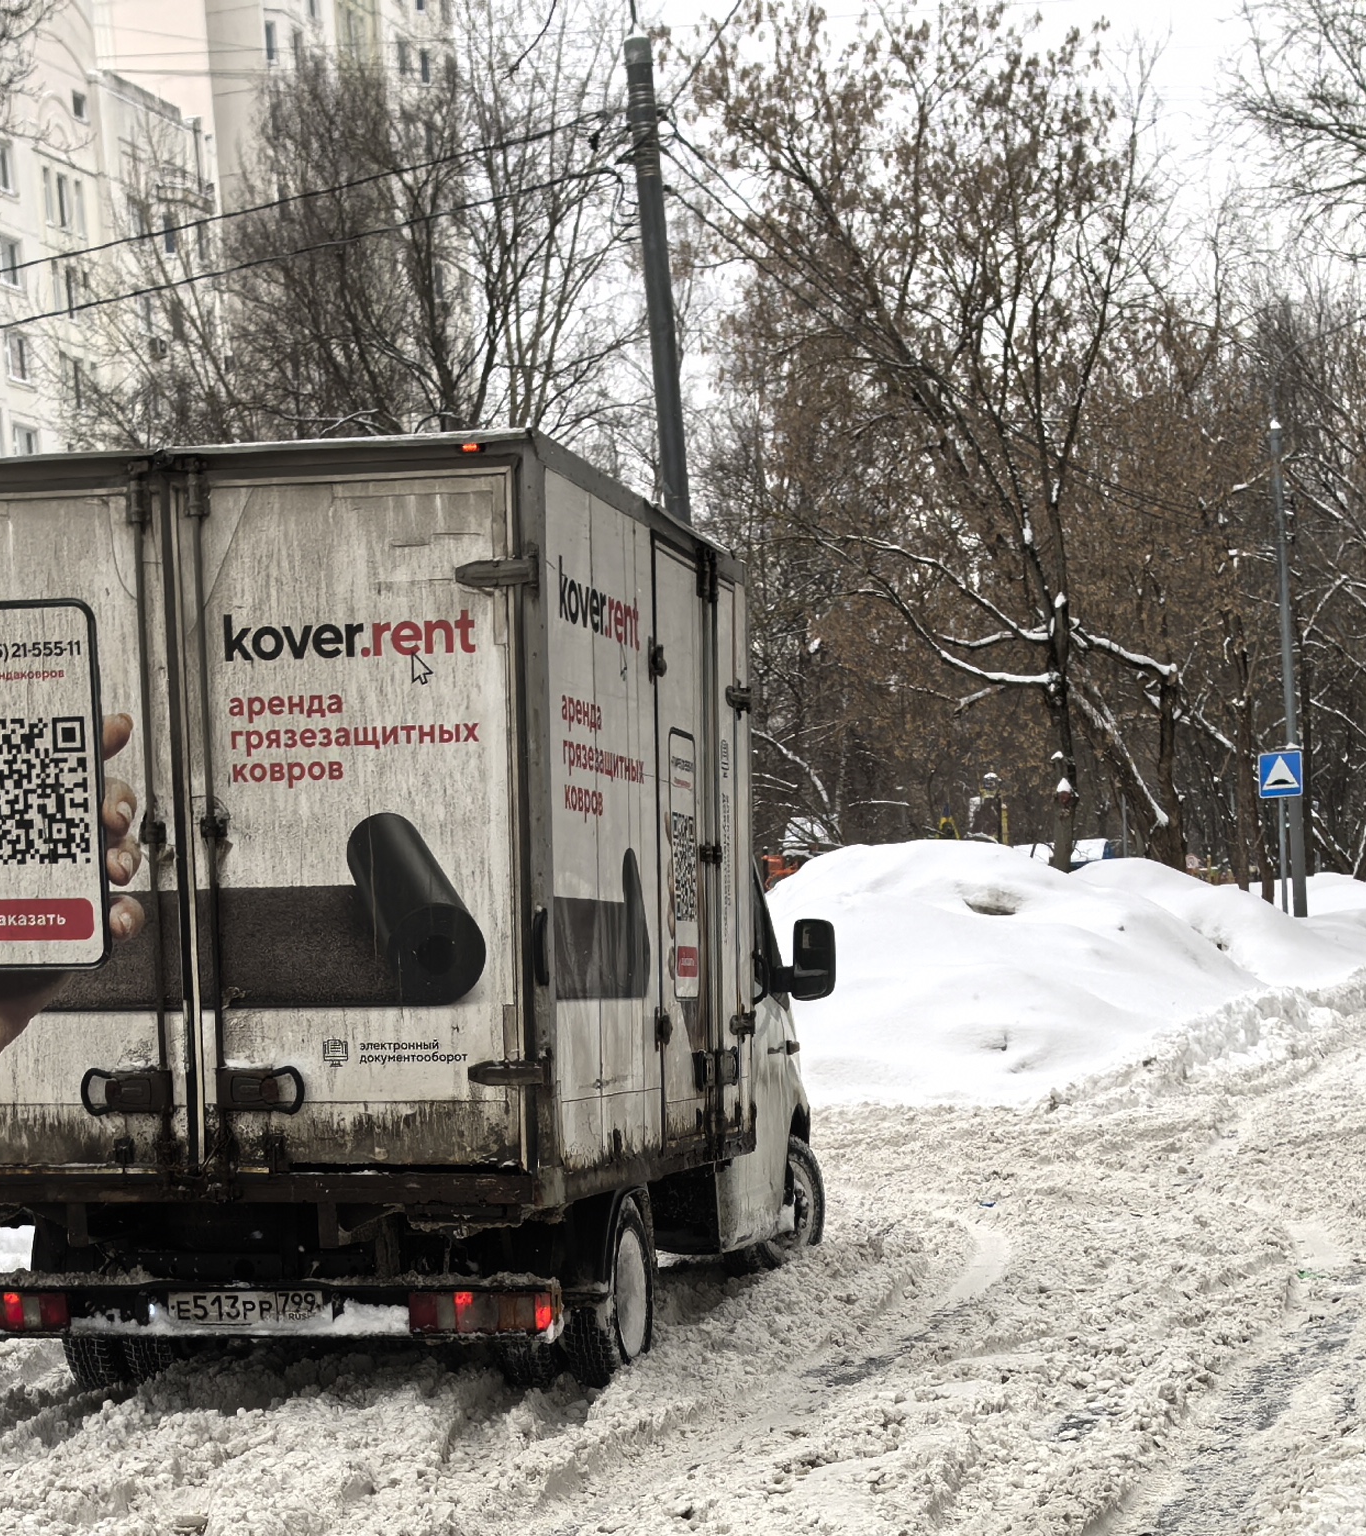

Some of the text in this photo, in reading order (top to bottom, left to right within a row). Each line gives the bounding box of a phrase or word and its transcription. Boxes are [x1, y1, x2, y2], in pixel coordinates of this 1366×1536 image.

[559, 555, 640, 651] kover.rent
[223, 609, 476, 662] kover.rent
[228, 693, 343, 723] аренда
[561, 694, 602, 731] аренда
[230, 722, 480, 757] грязезащитных
[232, 760, 344, 789] ковров
[563, 739, 645, 785] грязезащитных
[564, 784, 604, 821] ковров
[359, 1039, 439, 1052] электронный
[359, 1052, 468, 1065] документооборот
